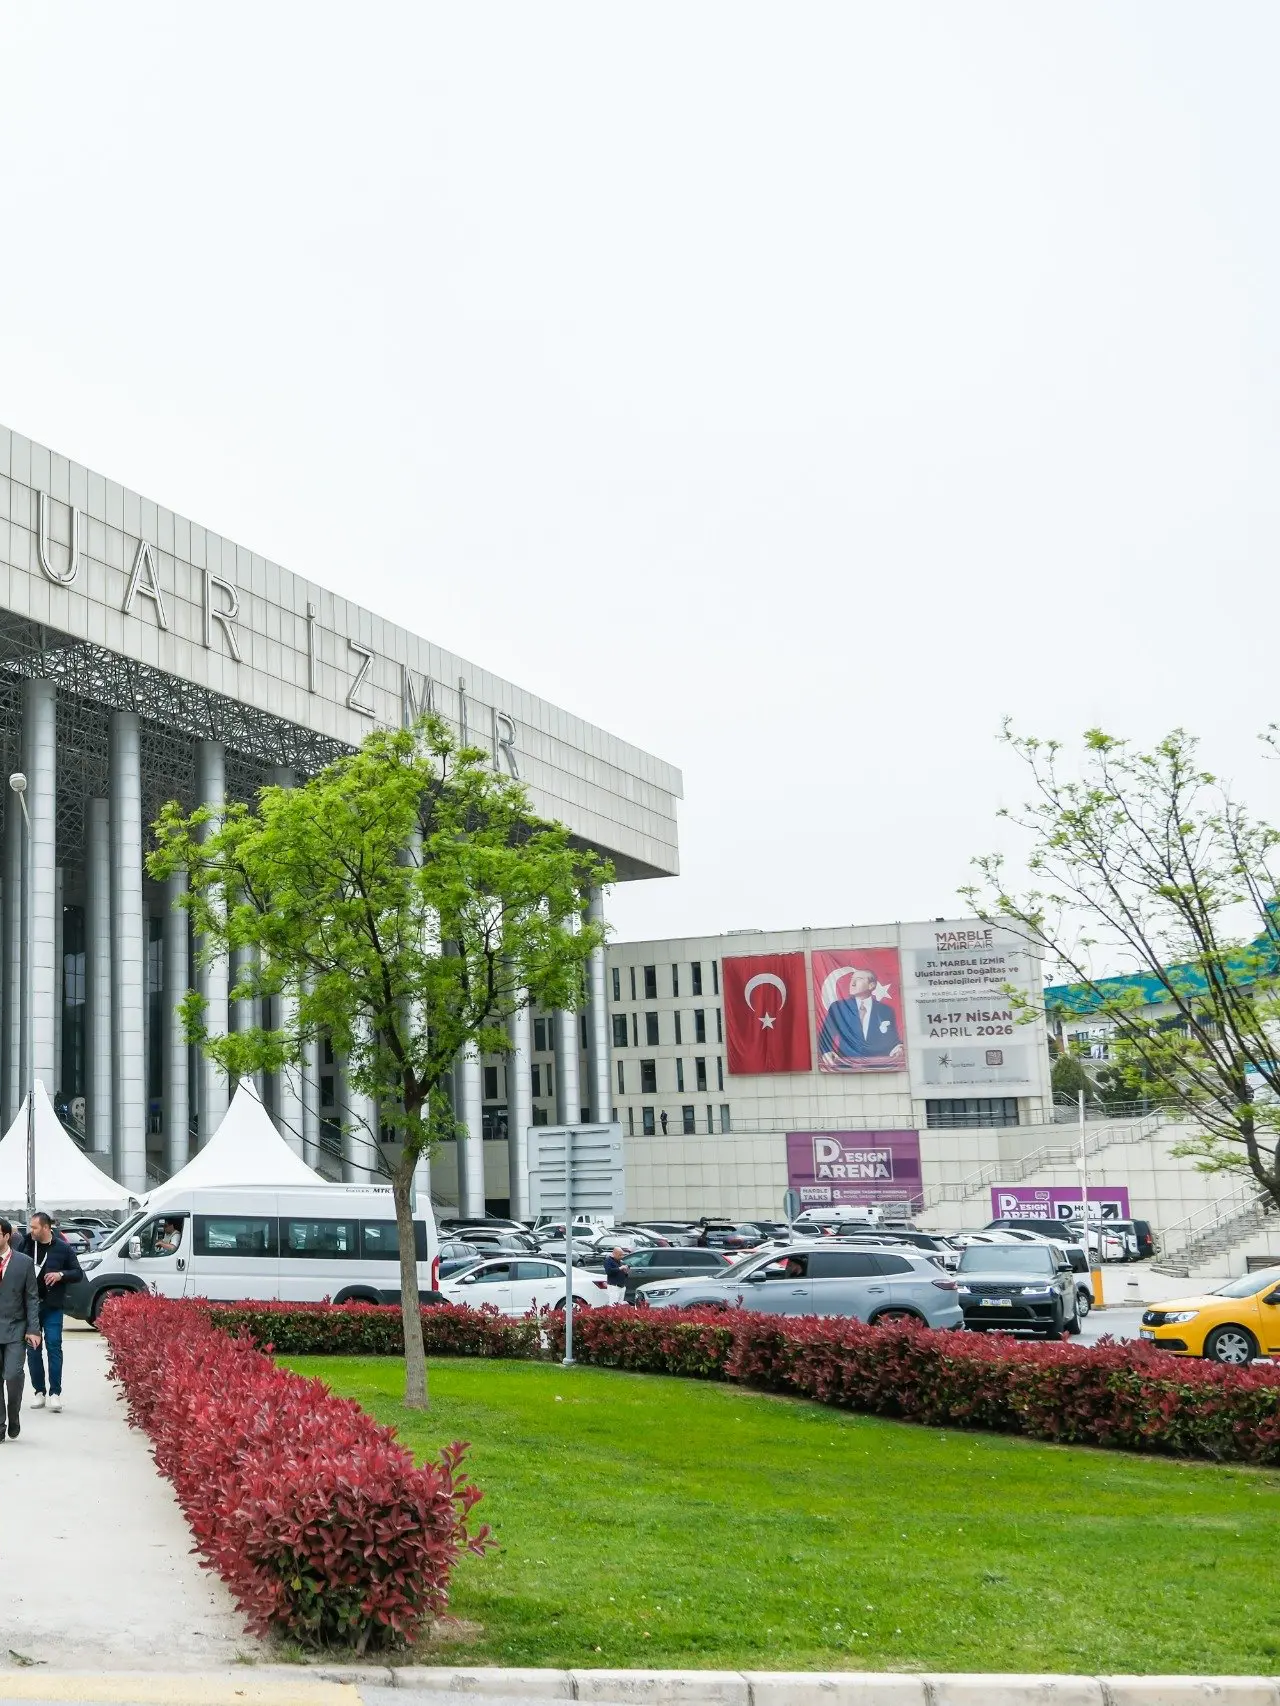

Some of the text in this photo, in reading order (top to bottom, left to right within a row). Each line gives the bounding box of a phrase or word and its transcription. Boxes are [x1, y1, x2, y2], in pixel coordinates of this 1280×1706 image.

[307, 602, 520, 780] İZMİR
[935, 929, 993, 942] MARBLE
[940, 959, 977, 967] MARBLE
[979, 957, 1005, 966] İZMİR
[915, 970, 965, 978] Uluslararası
[967, 967, 1006, 976] Doğaltaş
[928, 977, 981, 986] Teknolojileri
[927, 1010, 1013, 1024] 14-17 NİSAN
[929, 1025, 1013, 1038] APRIL 2026
[818, 1163, 890, 1178] ARENA
[1058, 1204, 1073, 1219] D
